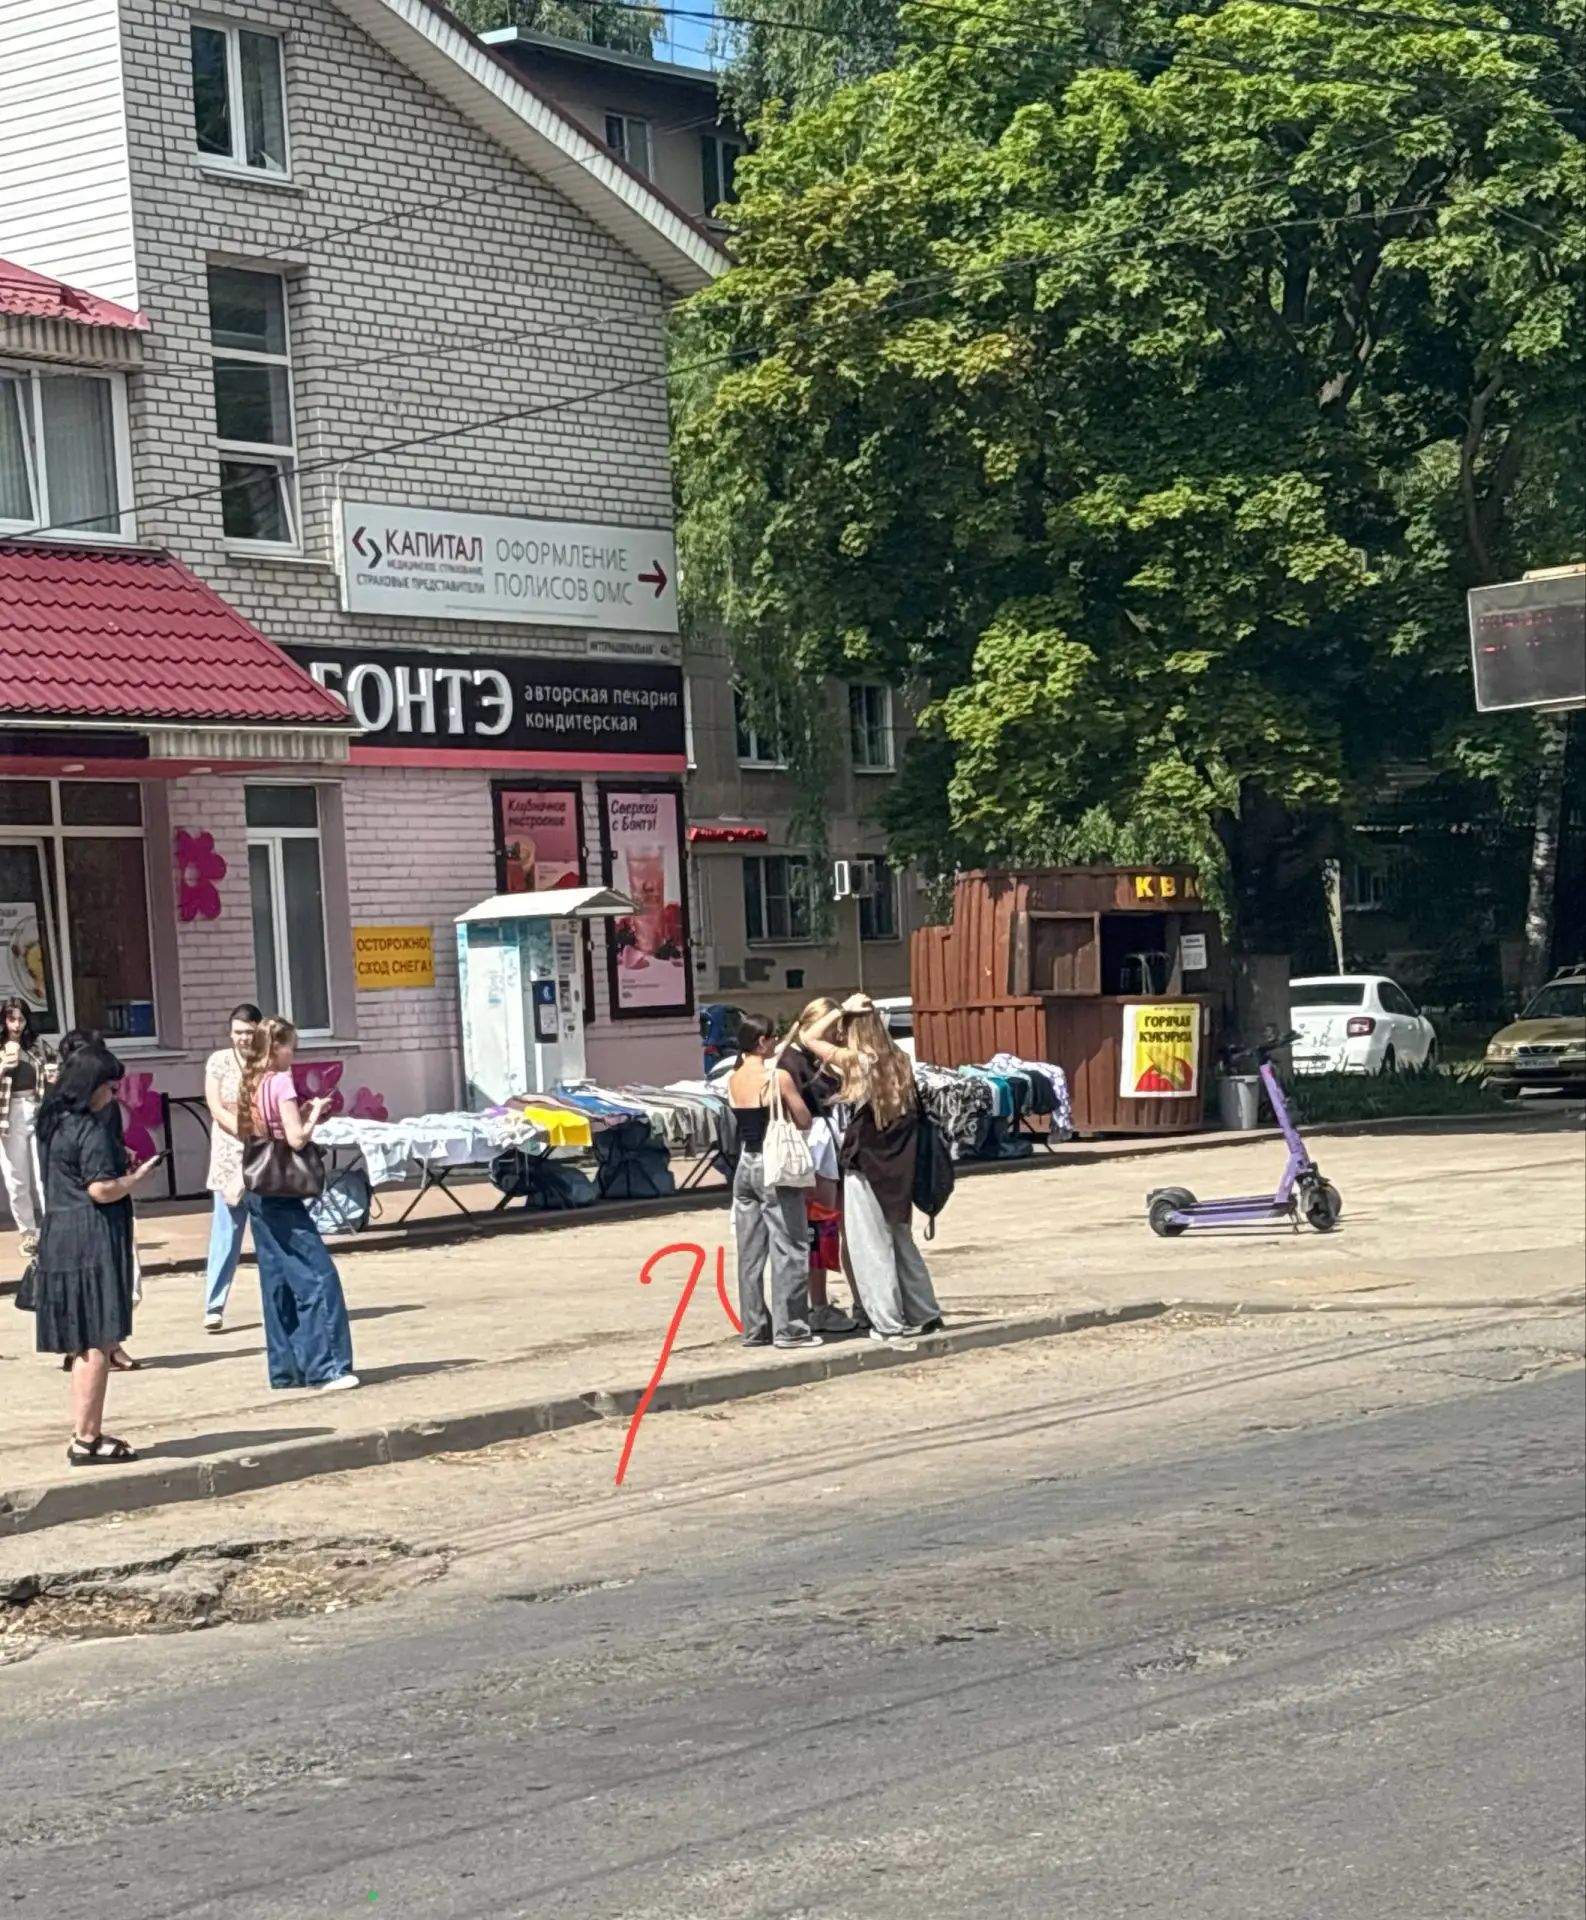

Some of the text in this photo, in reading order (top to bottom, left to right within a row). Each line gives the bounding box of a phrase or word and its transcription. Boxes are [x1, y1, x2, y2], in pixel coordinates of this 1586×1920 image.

[385, 528, 484, 562] КАПИТАЛ
[495, 538, 629, 572] ОФОРМЛЕНИЕ
[356, 574, 410, 589] СТРАХОВЫЕ
[494, 572, 634, 606] ПОЛИСОВ ОМС
[524, 684, 678, 711] авторская пекарня
[525, 711, 638, 736] кондитерская
[611, 819, 619, 832] с
[358, 959, 432, 976] СХОД СНЕГА!
[1144, 1015, 1192, 1028] ГОРЯЧАЯ
